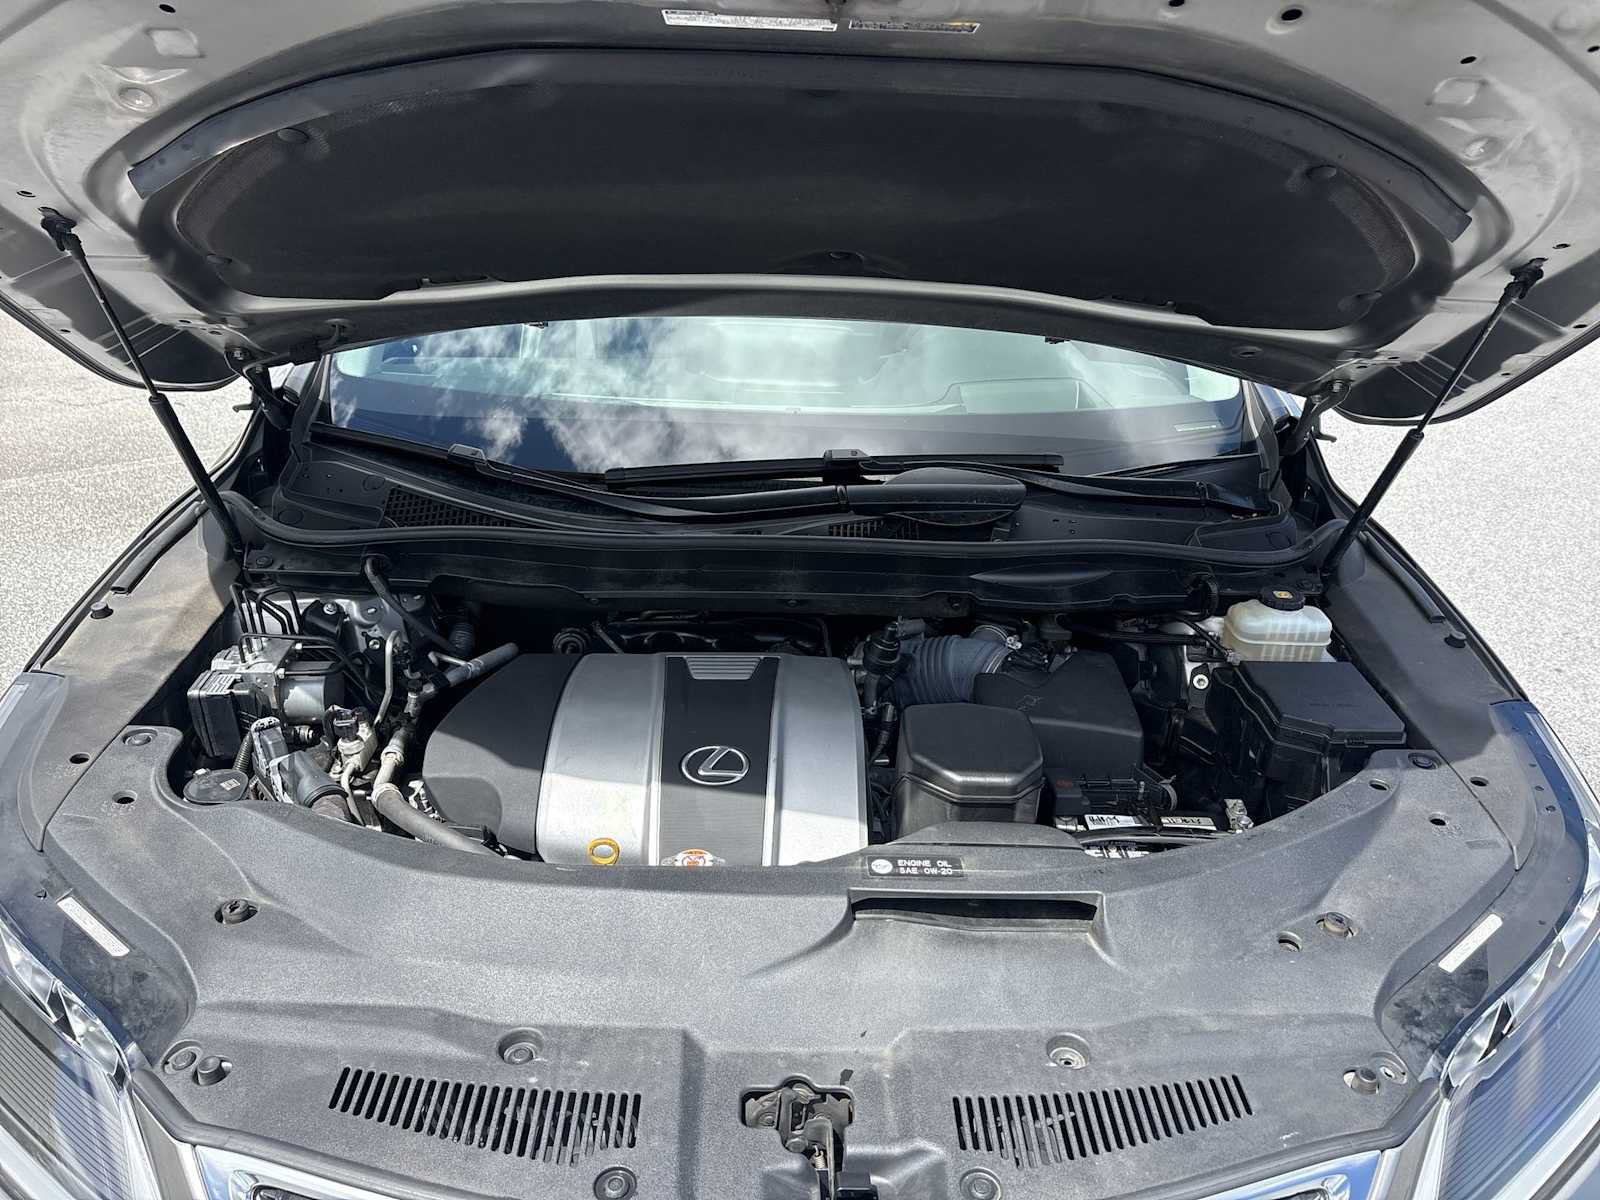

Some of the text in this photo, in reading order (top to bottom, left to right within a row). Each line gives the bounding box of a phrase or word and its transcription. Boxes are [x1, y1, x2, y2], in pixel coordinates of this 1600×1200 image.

[897, 859, 932, 867] ENGINE
[936, 860, 952, 868] OIL
[923, 867, 953, 875] 0W-20
